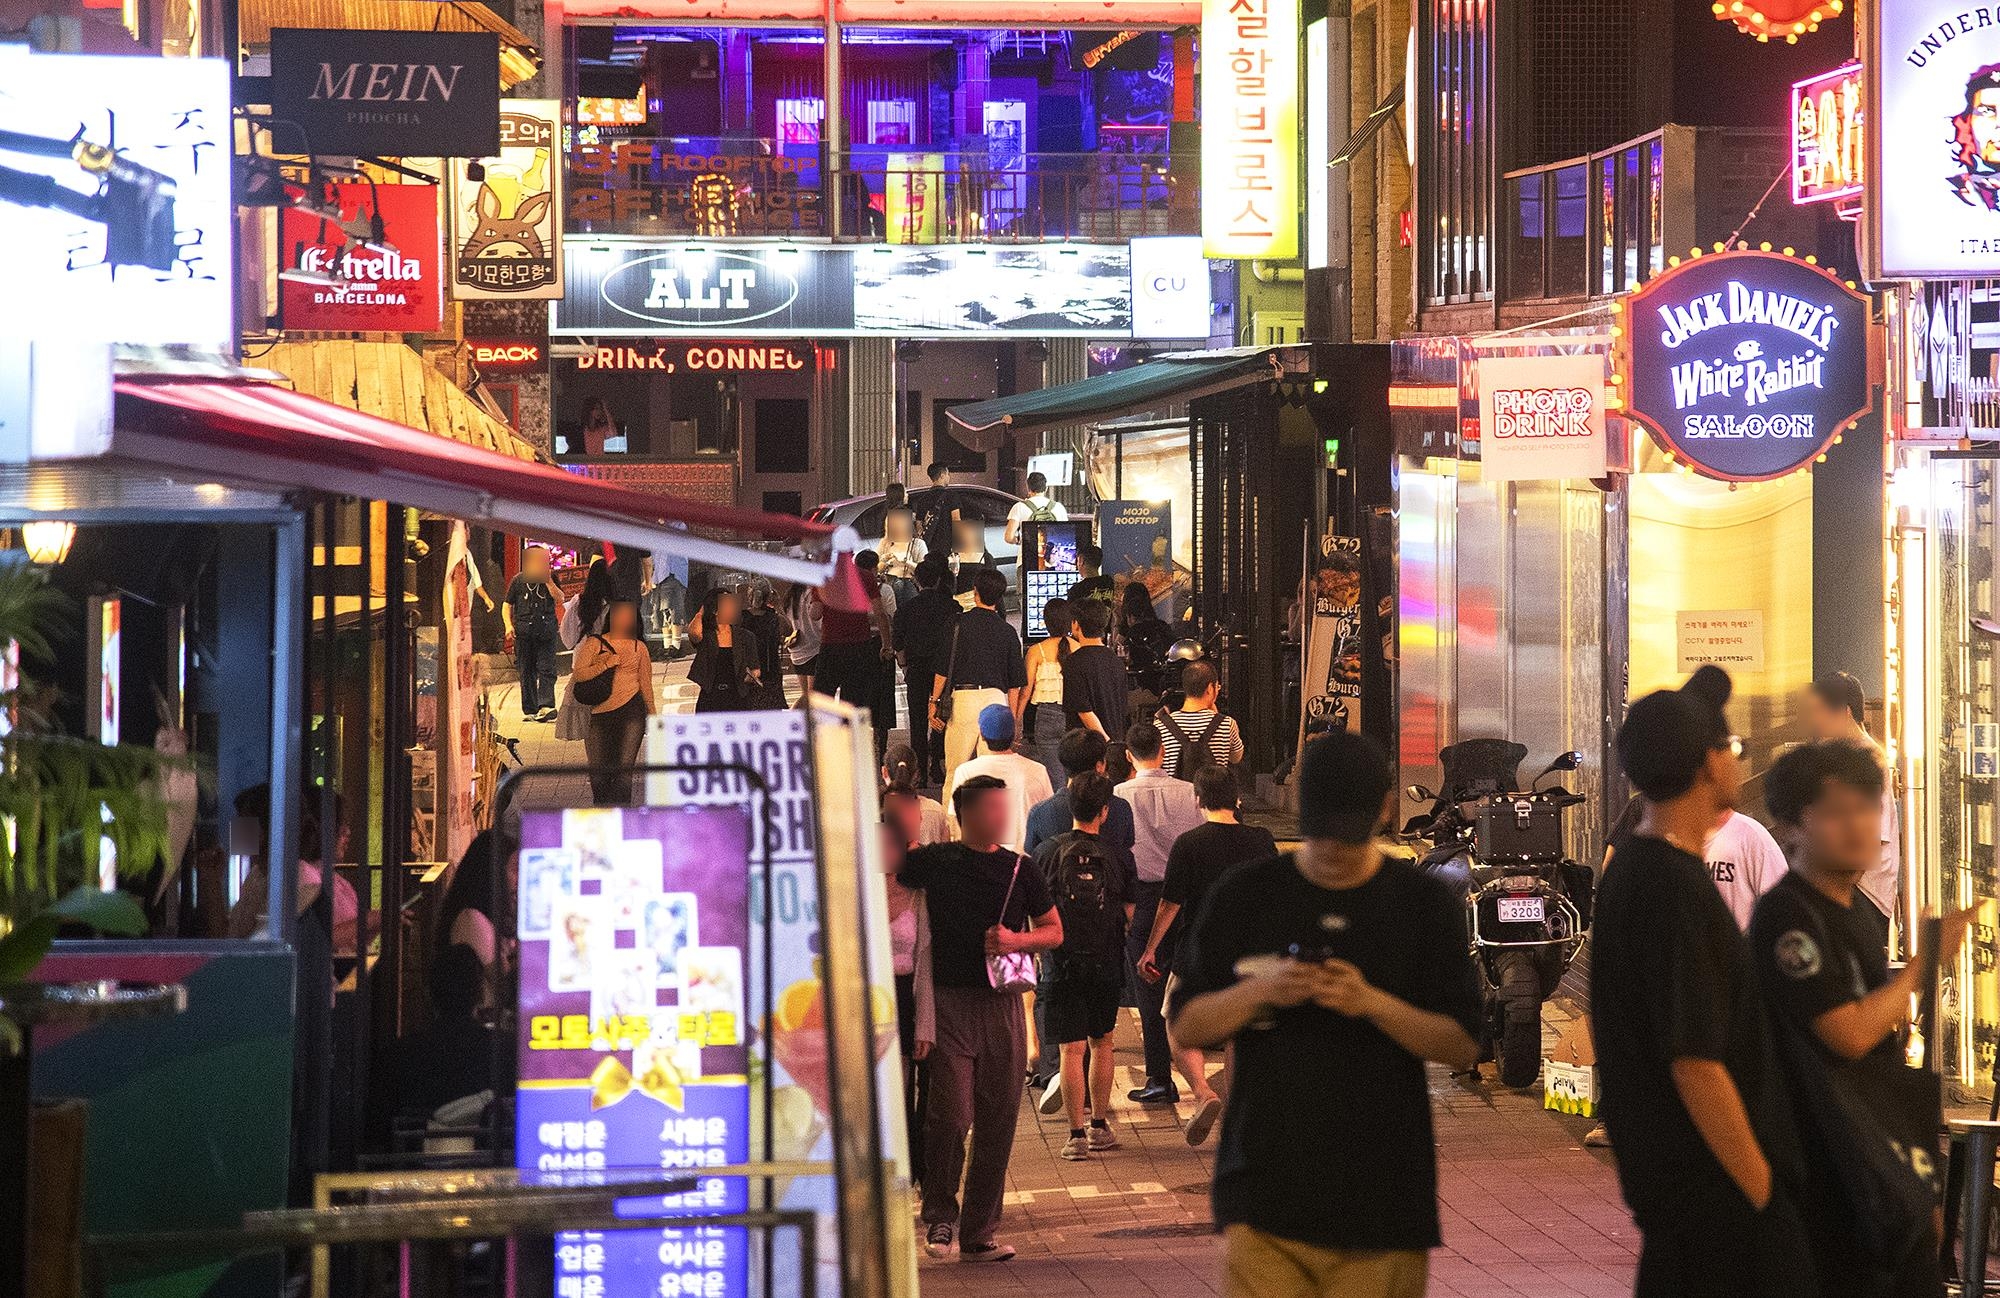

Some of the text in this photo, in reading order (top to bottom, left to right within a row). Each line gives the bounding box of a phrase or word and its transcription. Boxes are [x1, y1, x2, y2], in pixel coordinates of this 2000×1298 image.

[1907, 6, 2000, 68] UNDER
[308, 62, 463, 101] MEIN
[571, 144, 818, 175] 3F ROOFTOP
[571, 187, 653, 221] 2F
[467, 264, 546, 285] 기묘한모험
[1153, 277, 1186, 292] CU
[314, 292, 407, 305] BARCELONA
[643, 268, 756, 309] ALT
[1656, 280, 1840, 352] JACK DANIEL'S
[476, 347, 538, 362] BACK
[1670, 349, 1826, 410] White Rabbit
[1493, 388, 1593, 415] PHOTO
[1494, 412, 1593, 438] DRINK
[1683, 413, 1815, 439] SALOON
[1114, 516, 1159, 525] ROOFTOP
[1123, 508, 1150, 516] MOJO
[749, 798, 815, 852] SH
[1511, 907, 1541, 918] 3203
